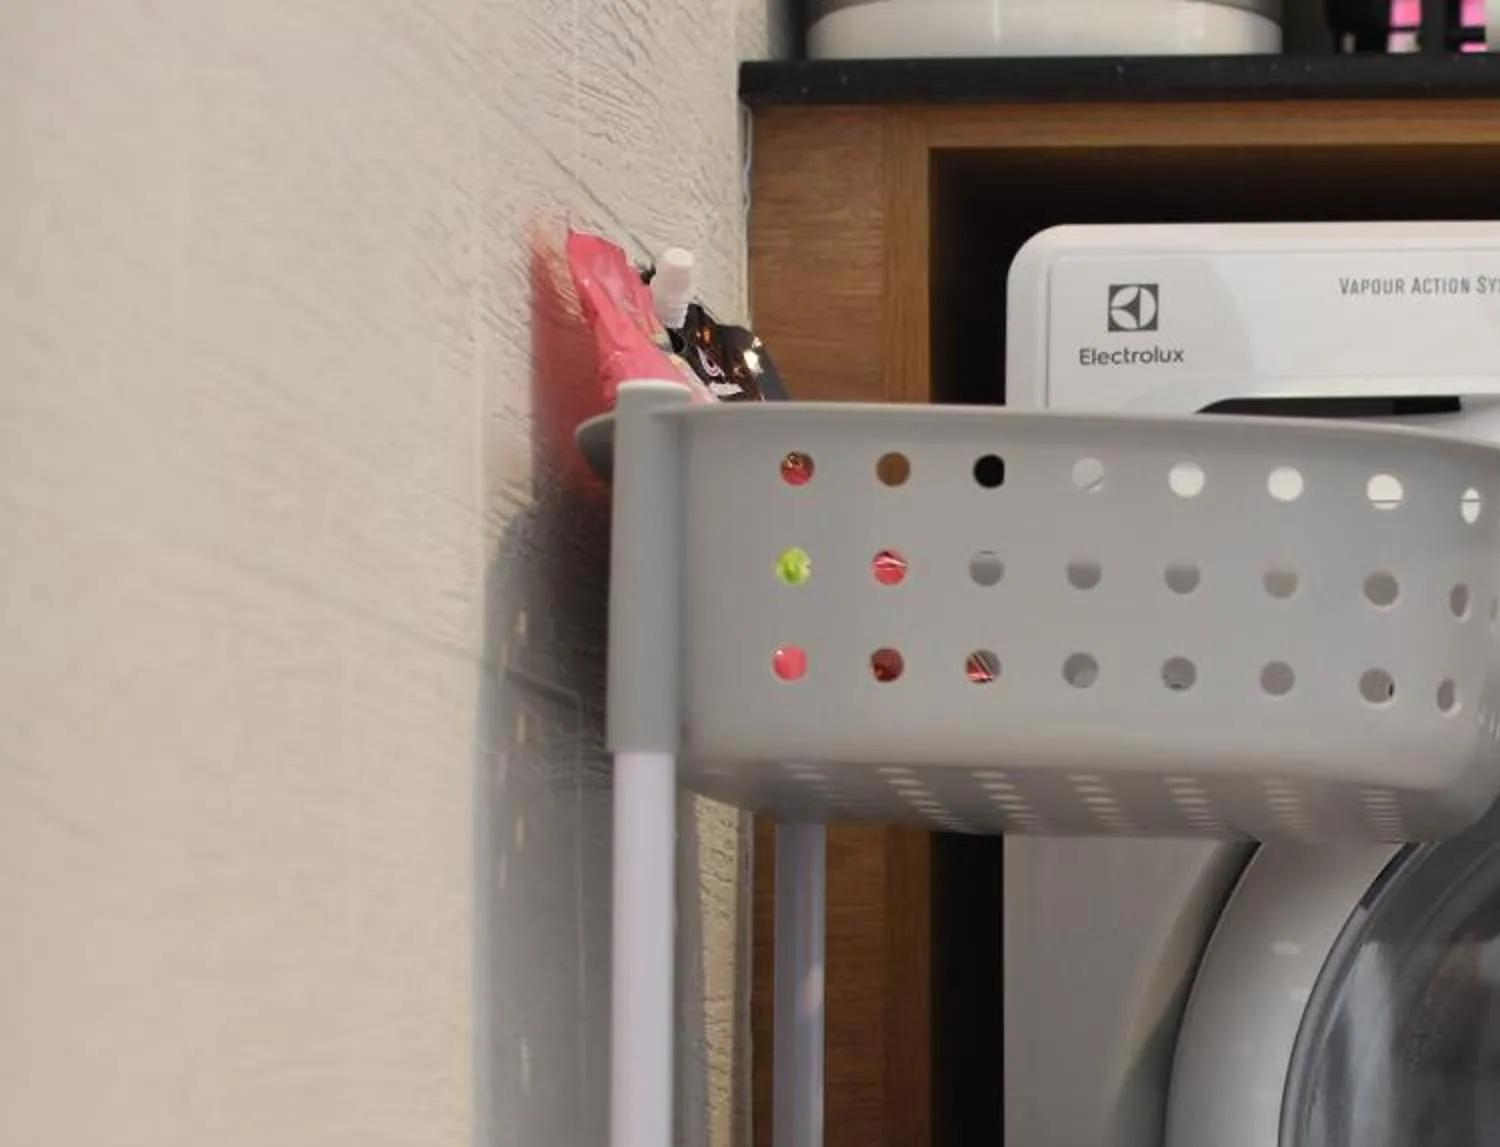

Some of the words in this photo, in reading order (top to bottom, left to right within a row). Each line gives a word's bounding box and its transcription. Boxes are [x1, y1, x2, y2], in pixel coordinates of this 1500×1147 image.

[1339, 278, 1405, 295] VAPOUR
[1412, 277, 1470, 295] ACTION
[1079, 346, 1184, 366] Electrolux
